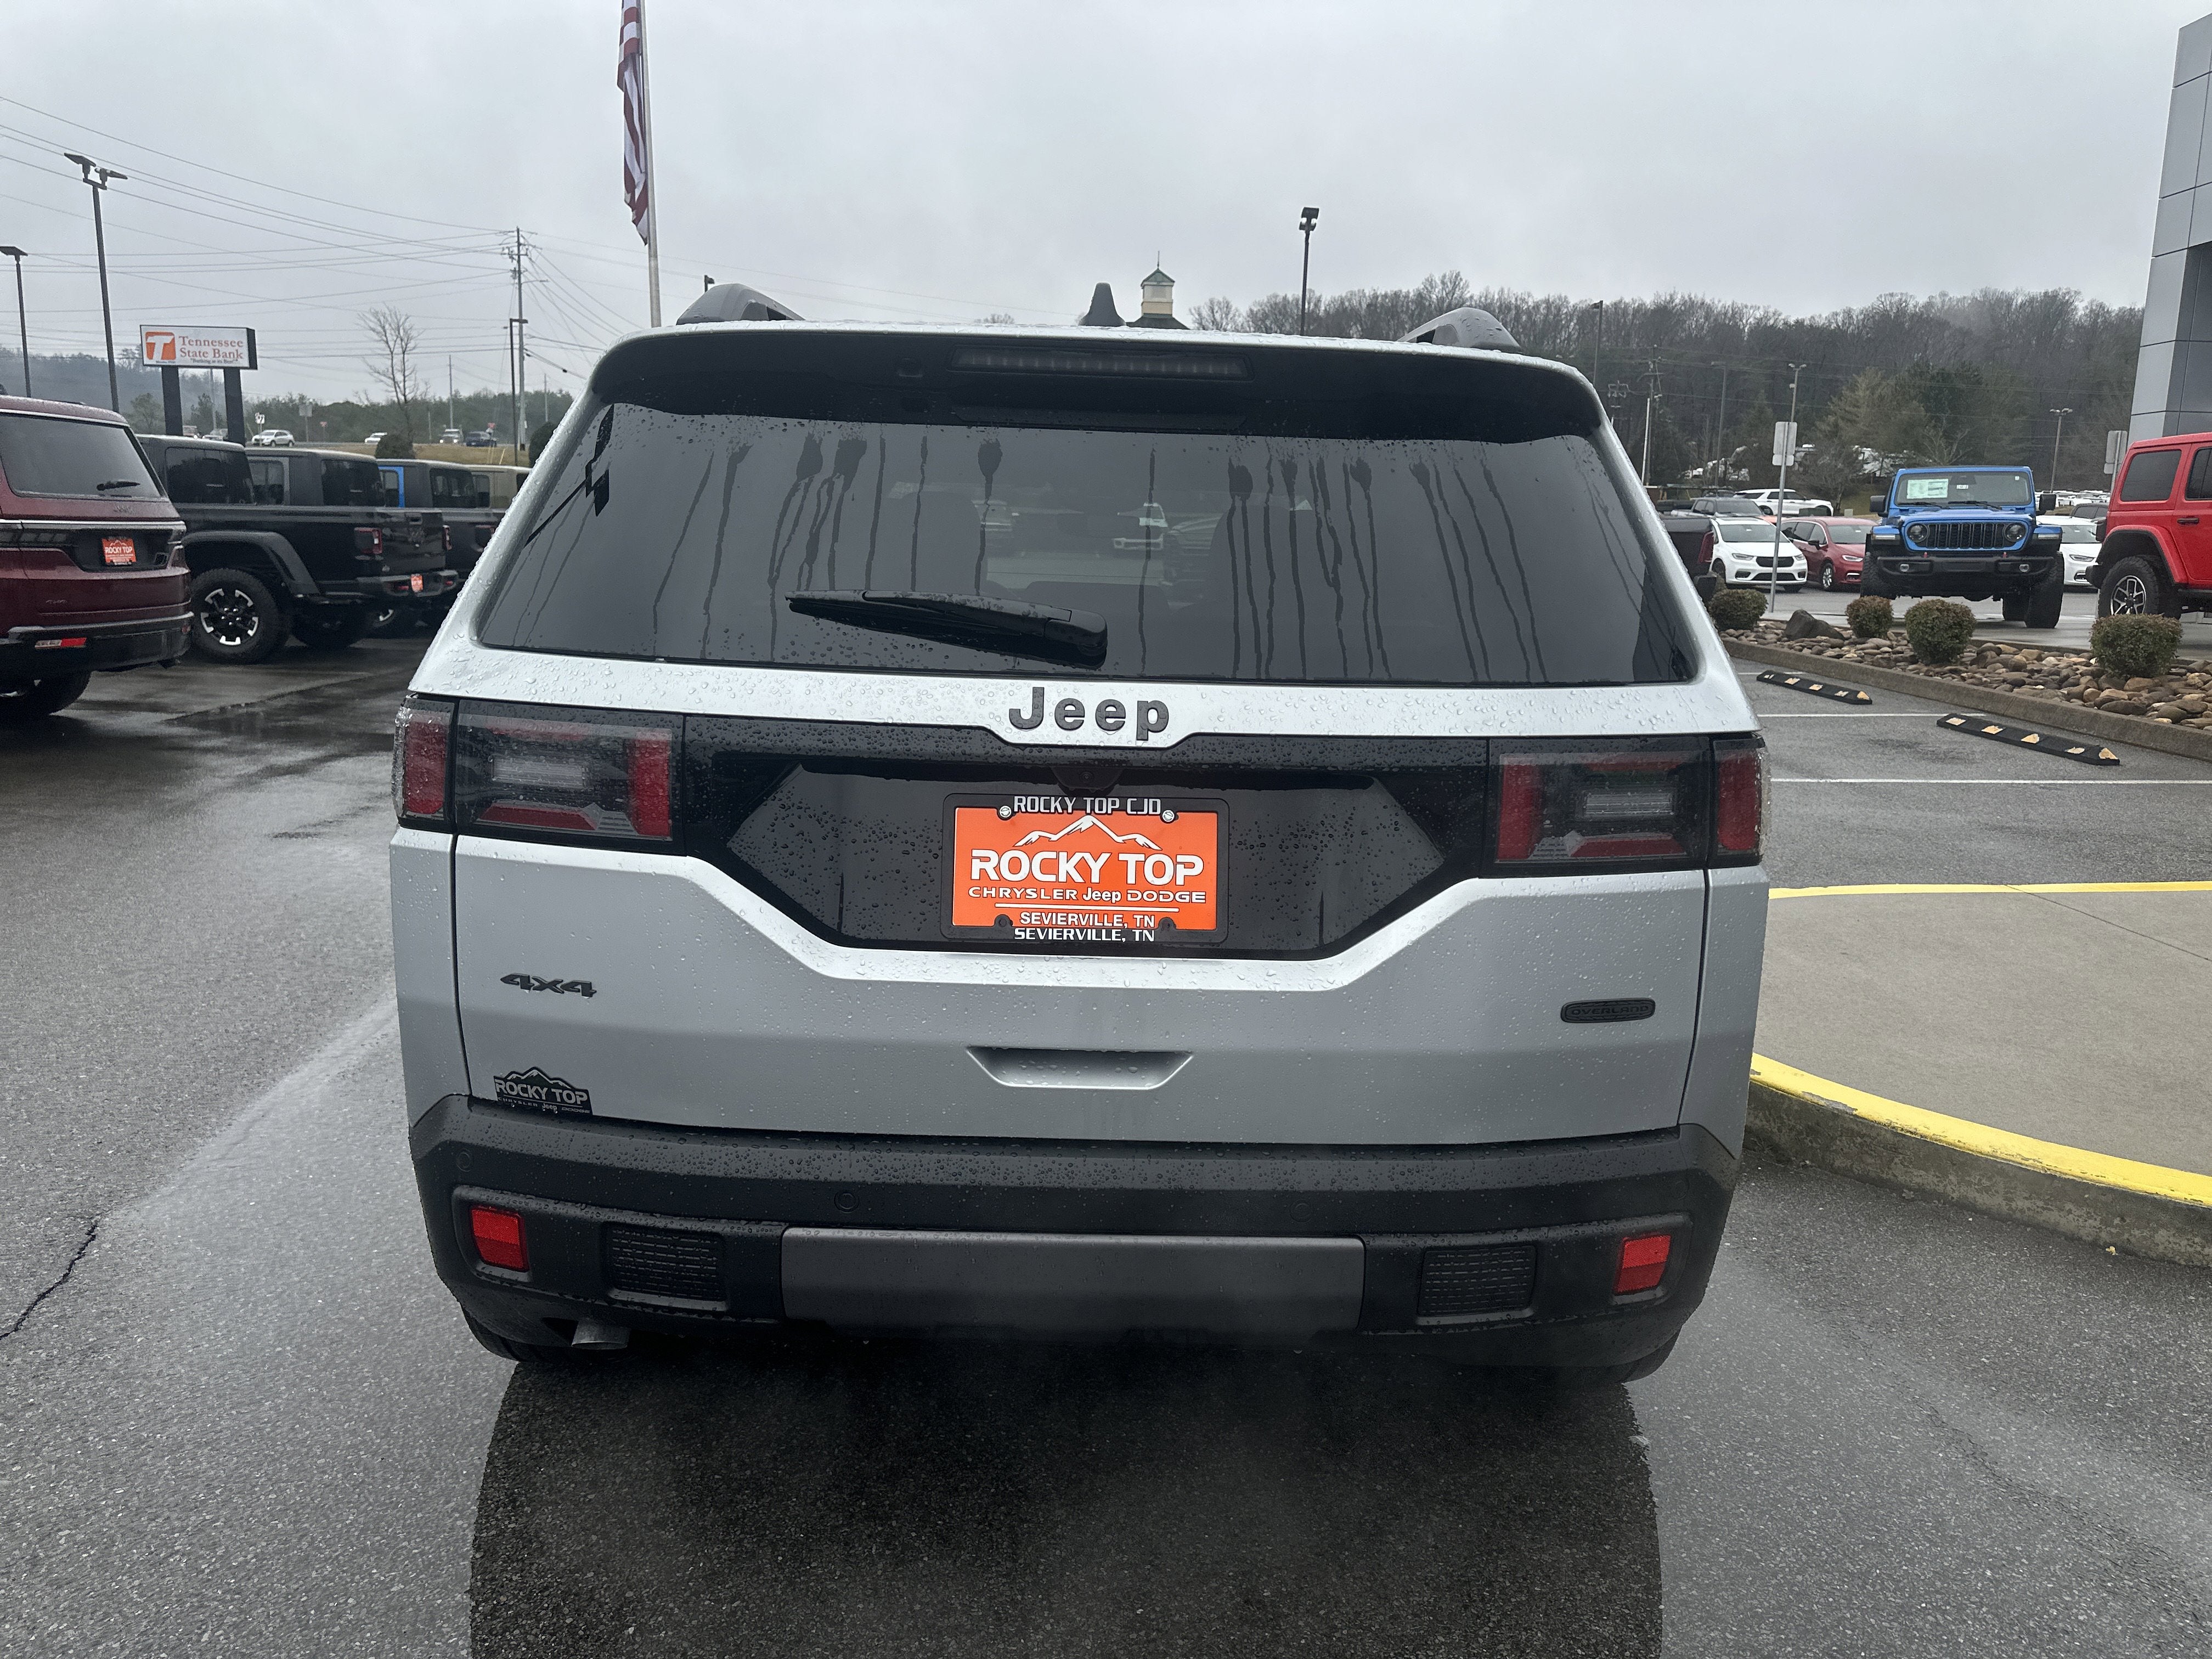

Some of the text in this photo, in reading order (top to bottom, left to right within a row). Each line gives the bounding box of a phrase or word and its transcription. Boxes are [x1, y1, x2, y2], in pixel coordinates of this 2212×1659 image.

[179, 336, 244, 347] Tennessee
[180, 347, 244, 359] State Bank
[1009, 687, 1169, 741] Jeep
[1014, 795, 1161, 815] ROCKY TOP CJD
[970, 849, 1204, 887] ROCKY TOP
[968, 887, 1206, 904] CHRYSLER Jeep DODGE
[1020, 912, 1155, 929] SEVIERVILLE, TN
[1014, 928, 1155, 943] SEVIERVILLE, TN
[500, 973, 597, 998] 4x4
[1571, 1005, 1649, 1015] OVERLAND
[494, 1079, 588, 1104] ROCKY TOP
[498, 1097, 538, 1107] CHRYSLER
[542, 1103, 557, 1111] Jeep
